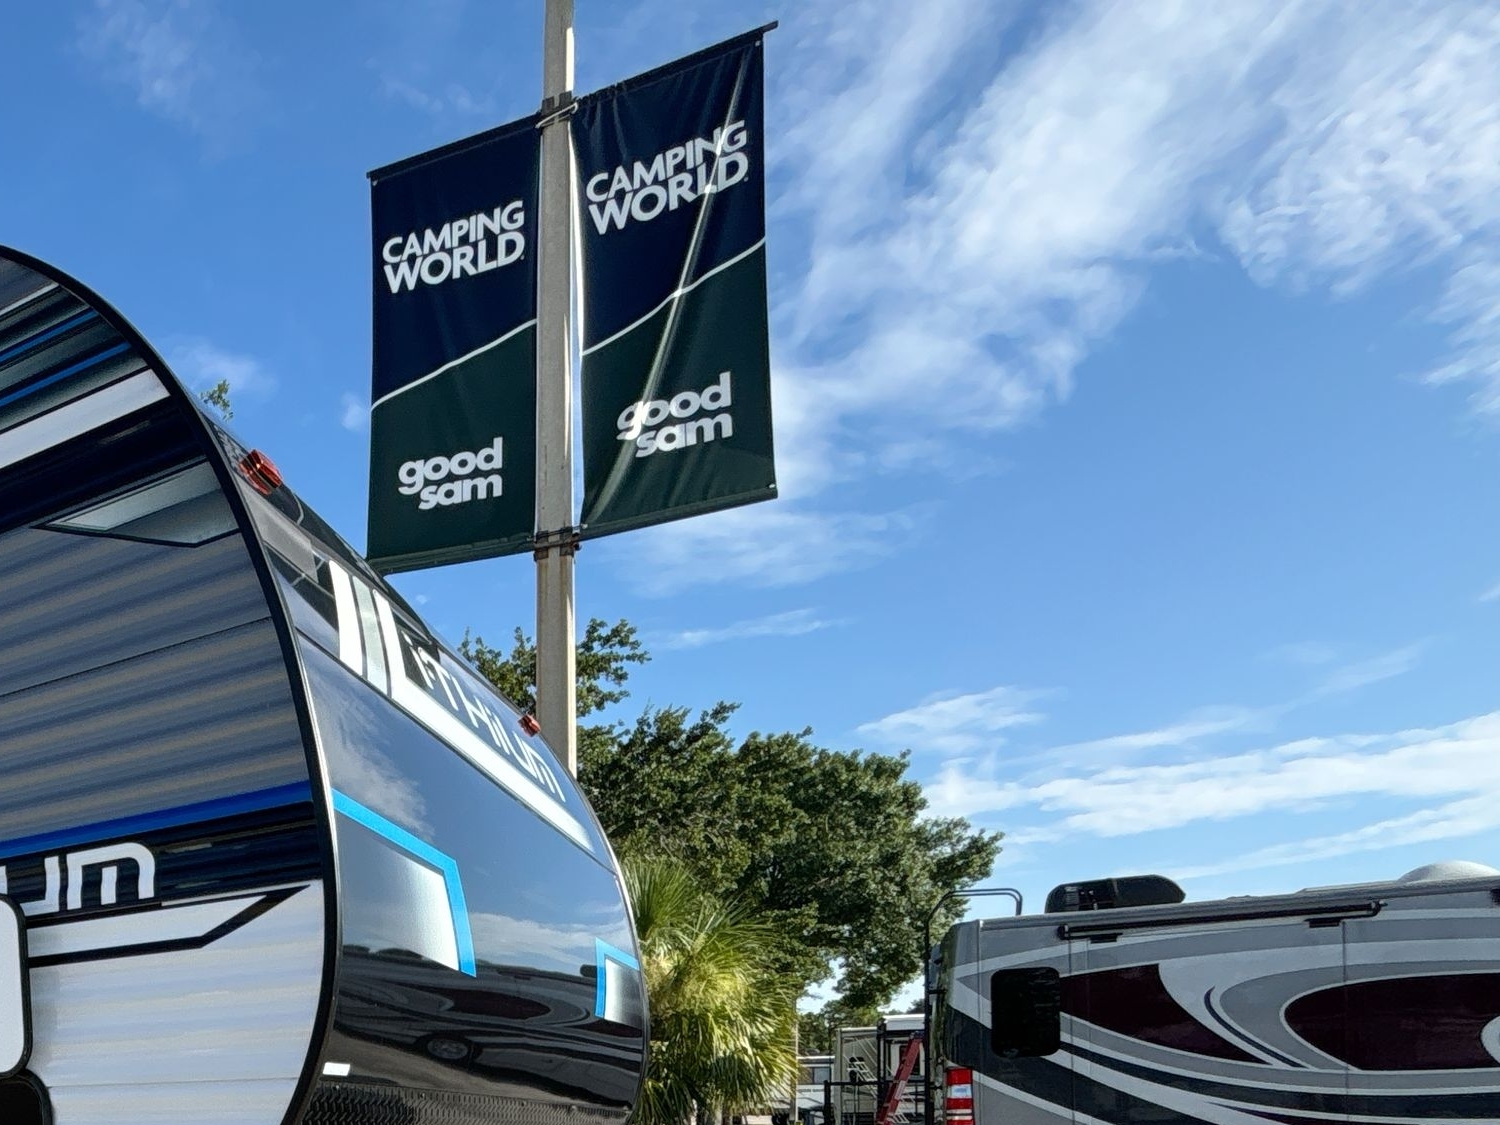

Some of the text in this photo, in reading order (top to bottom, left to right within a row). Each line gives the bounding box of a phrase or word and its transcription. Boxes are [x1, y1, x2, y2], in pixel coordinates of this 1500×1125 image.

[586, 120, 748, 203] CAMPING
[382, 200, 525, 264] CAMPING
[616, 371, 732, 441] good
[635, 413, 733, 458] sam
[398, 436, 503, 495] good
[418, 474, 503, 510] sam
